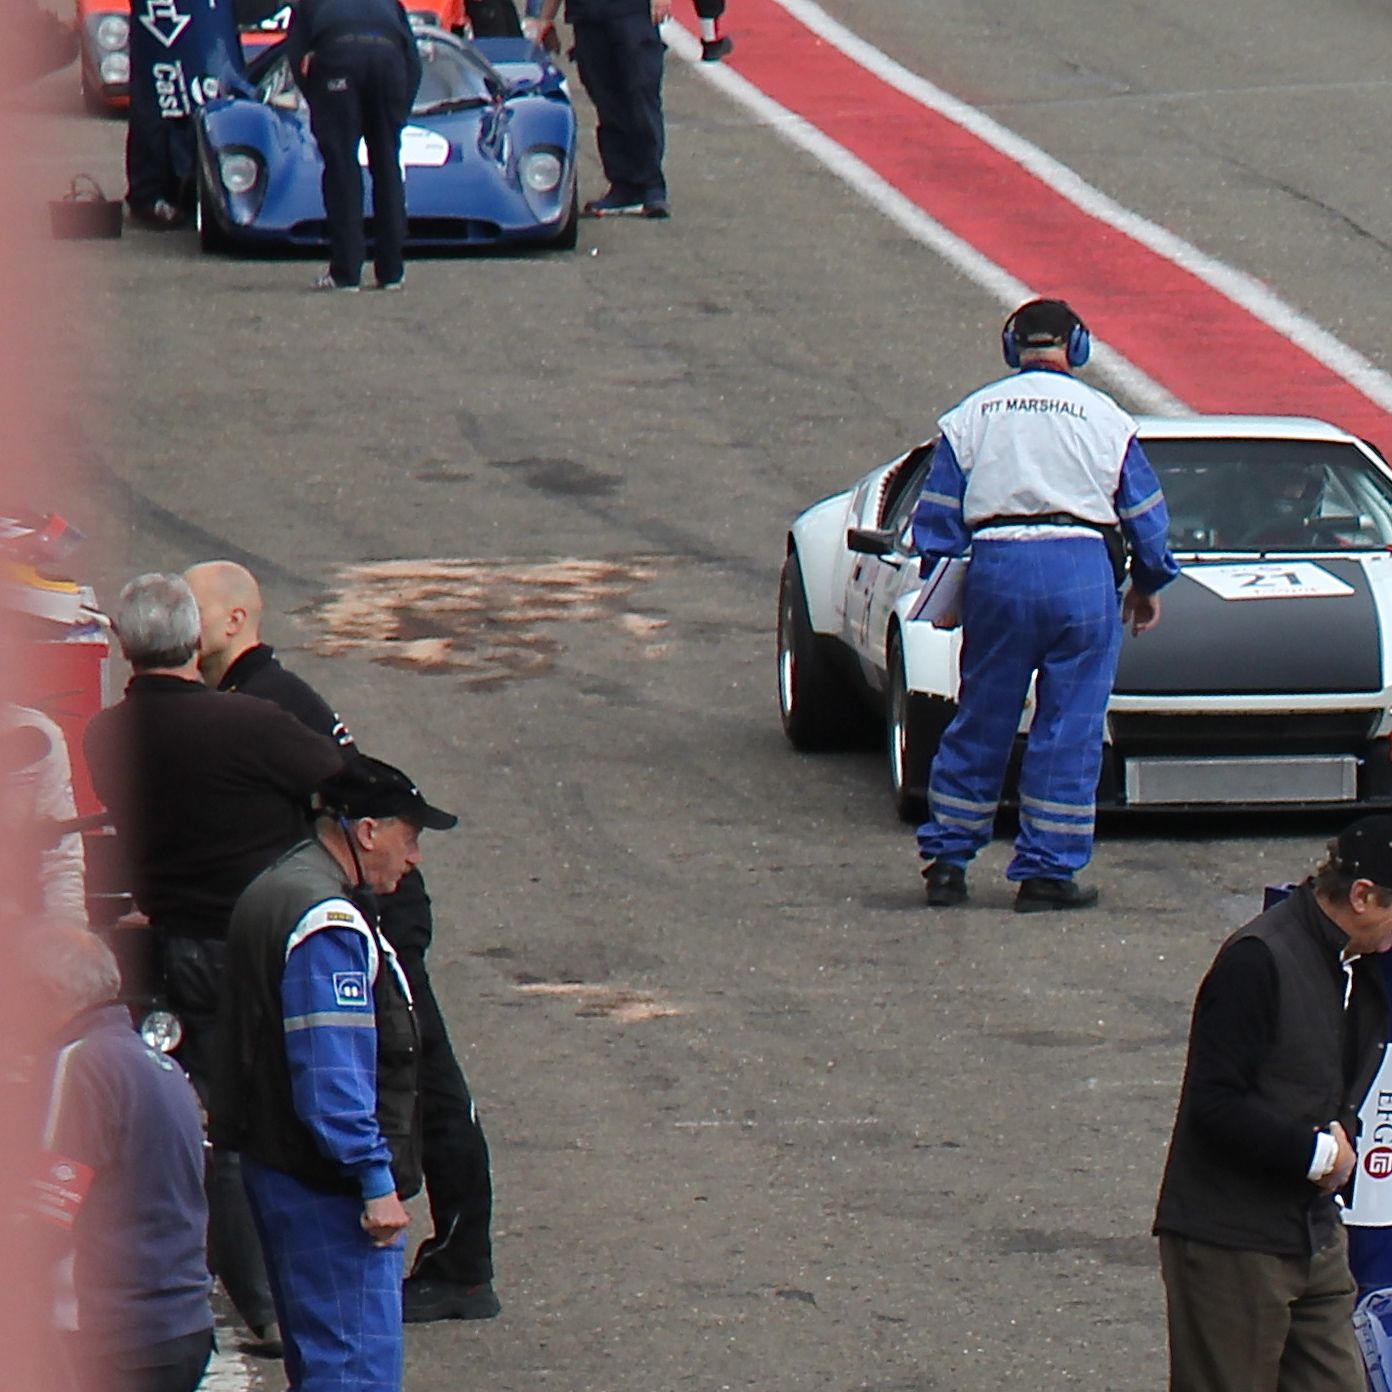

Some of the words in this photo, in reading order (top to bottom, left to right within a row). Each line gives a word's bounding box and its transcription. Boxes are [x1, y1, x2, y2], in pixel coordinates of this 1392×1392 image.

[981, 399, 1003, 416] PIT
[1006, 397, 1087, 421] MARSHALL
[1231, 572, 1302, 588] 21
